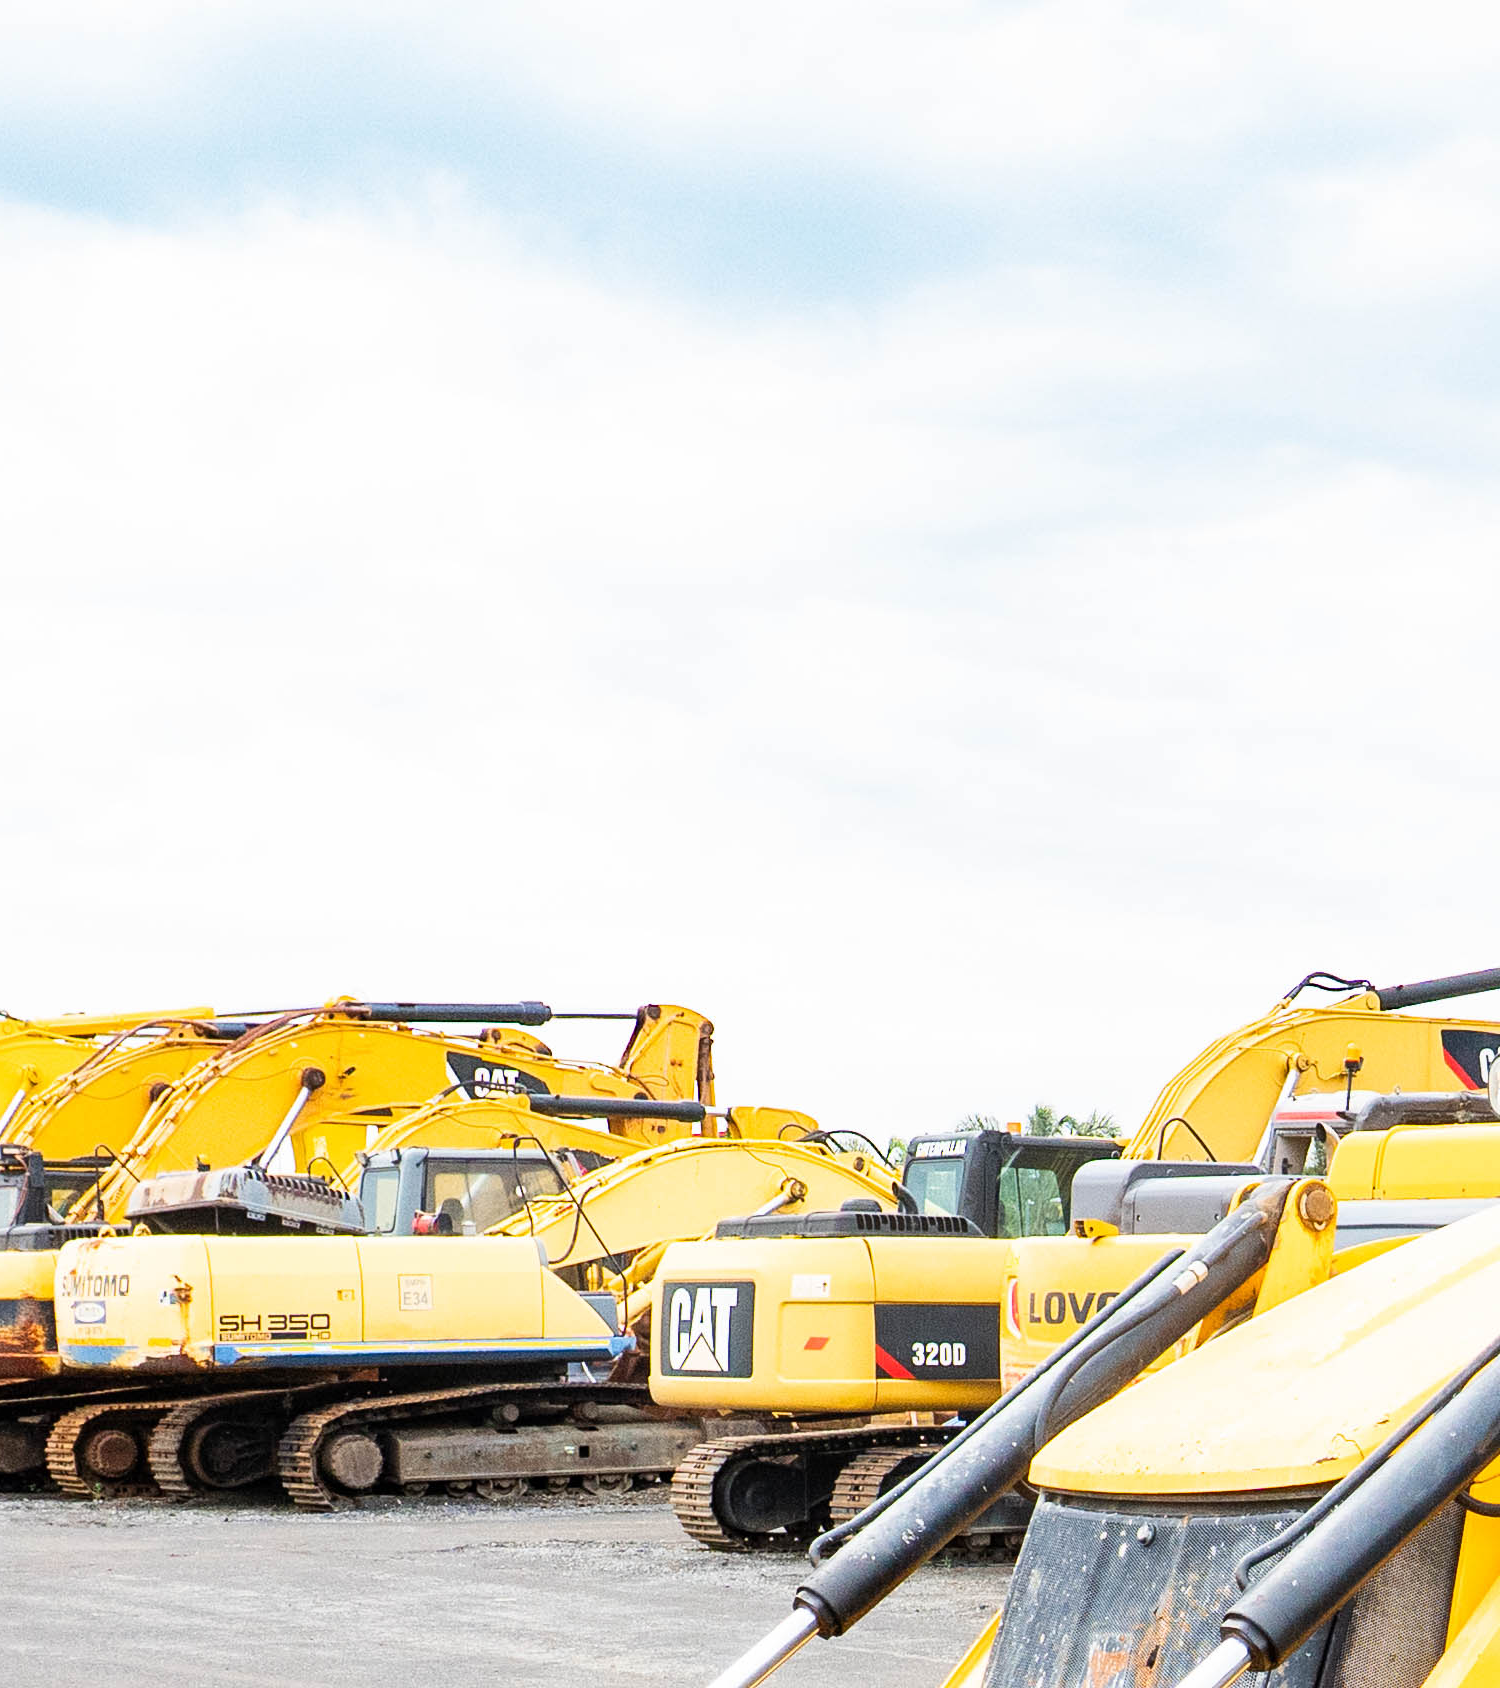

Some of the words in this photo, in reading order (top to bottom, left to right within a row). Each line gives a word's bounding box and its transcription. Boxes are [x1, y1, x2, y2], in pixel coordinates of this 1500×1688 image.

[915, 1139, 967, 1158] CATERPILLAR
[62, 1274, 131, 1297] SUMITOMO
[219, 1314, 262, 1332] SH
[267, 1313, 331, 1331] 350
[669, 1286, 739, 1373] CAT
[911, 1342, 967, 1367] 320D
